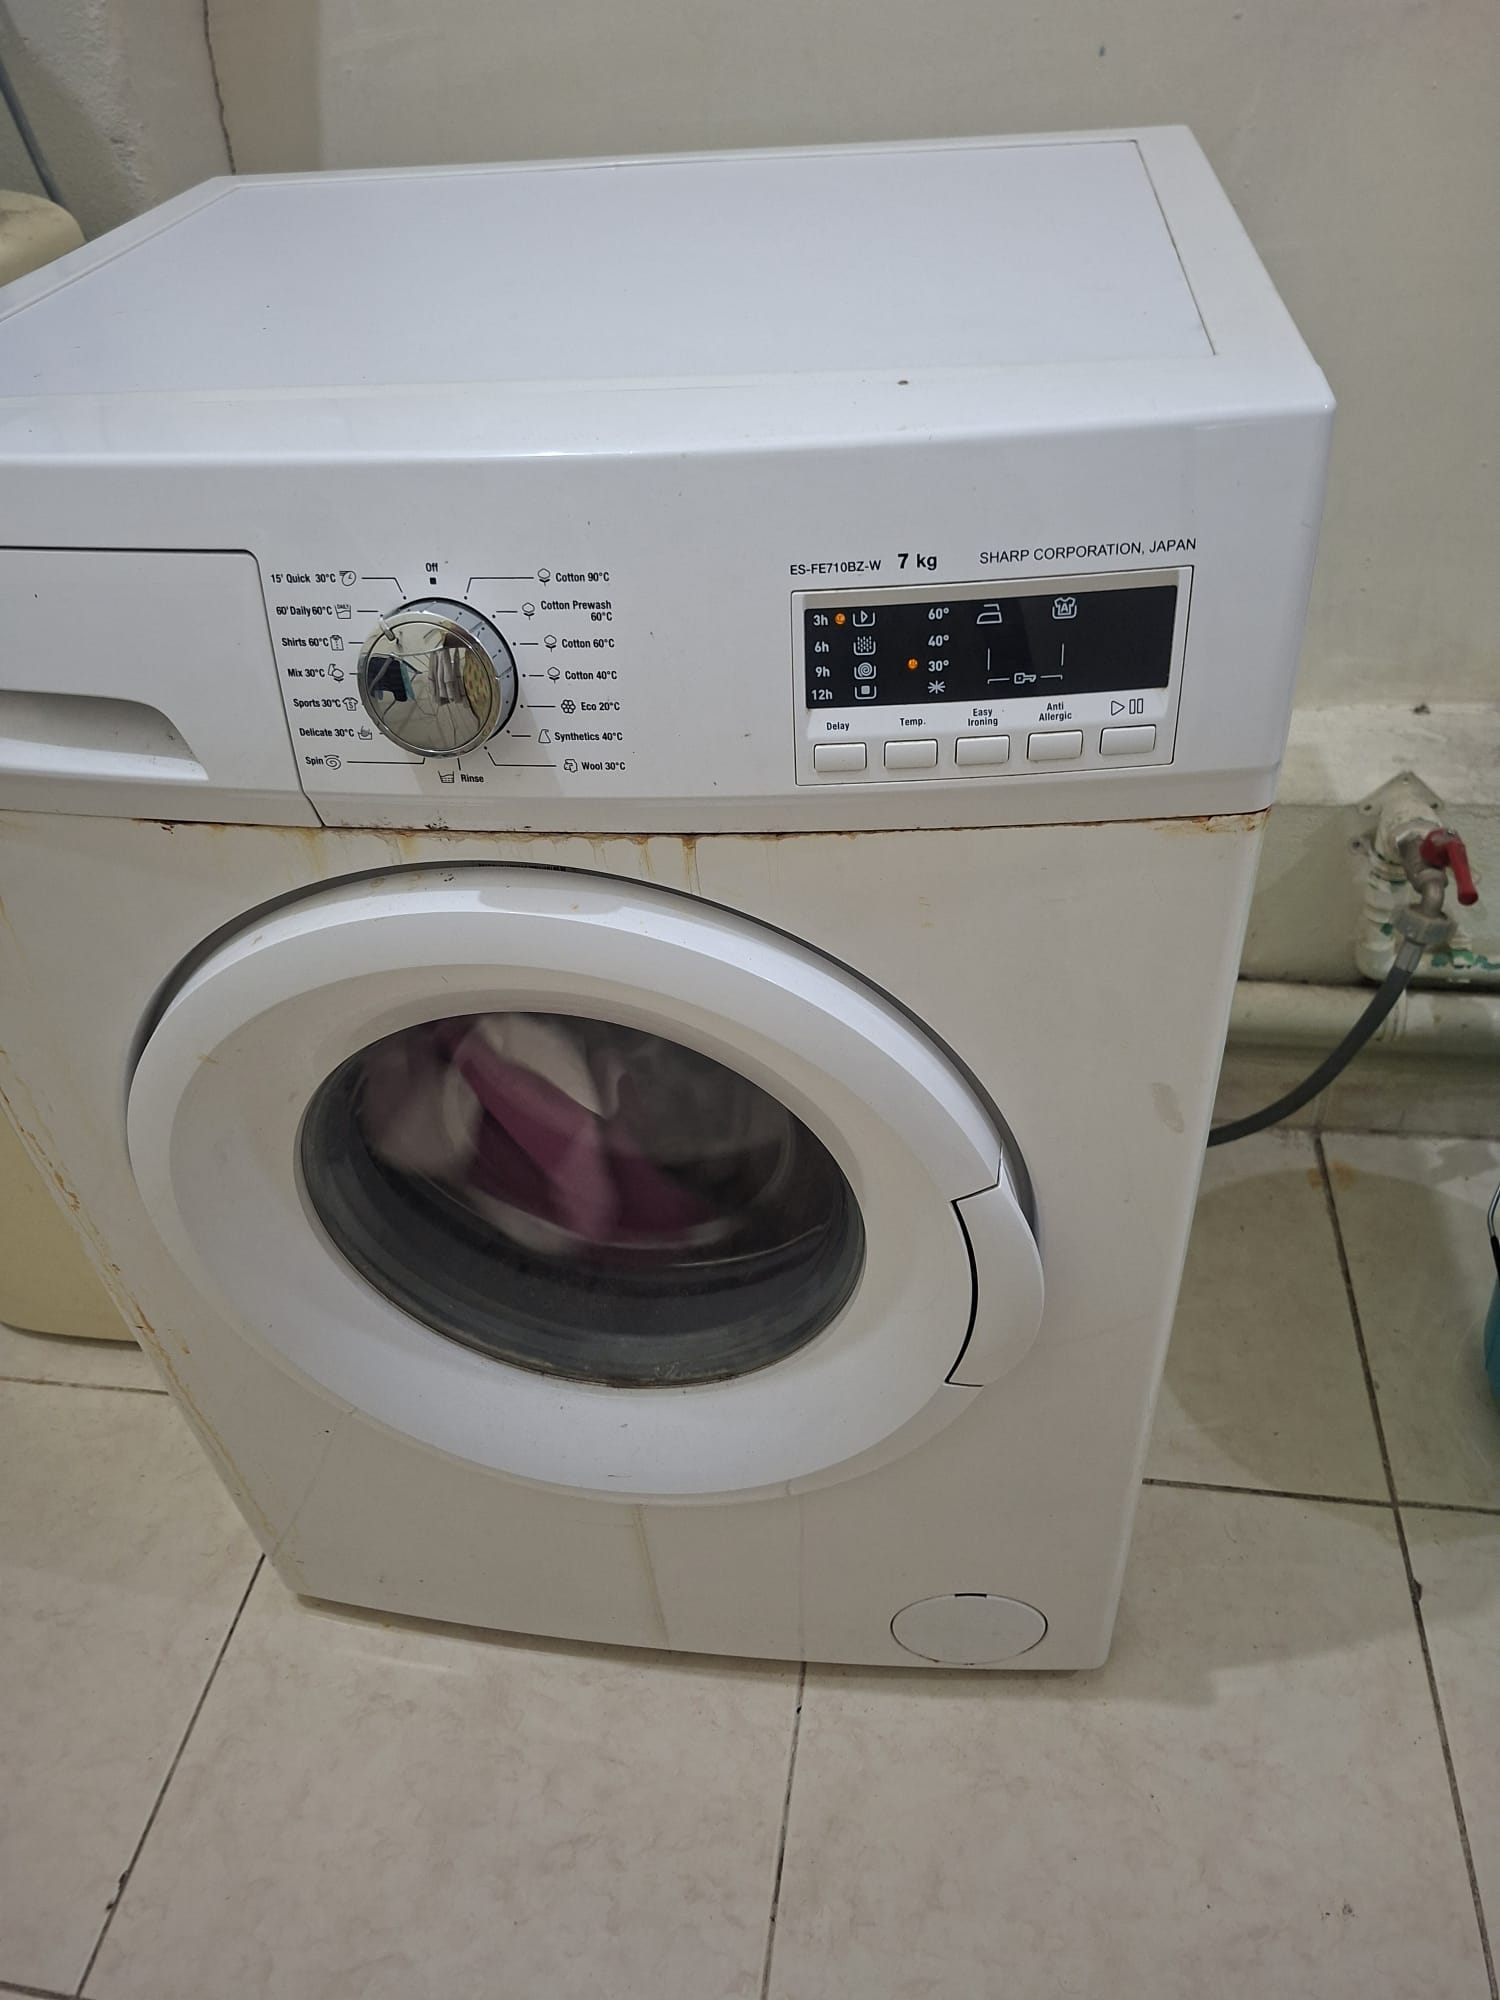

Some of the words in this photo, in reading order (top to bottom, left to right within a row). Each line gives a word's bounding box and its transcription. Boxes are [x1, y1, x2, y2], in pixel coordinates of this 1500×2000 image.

[979, 549, 1029, 564] SHARP
[1033, 543, 1144, 560] CORPORATION,
[1149, 539, 1196, 552] JAPAN
[898, 554, 909, 569] 7
[916, 554, 937, 569] kg
[426, 563, 438, 572] Off
[790, 560, 881, 575] ES-FE710BZ-W
[271, 574, 284, 583] 15'
[287, 574, 310, 583] Quick
[315, 574, 336, 583] 30°C
[556, 573, 585, 582] Cotton
[588, 573, 609, 581] 90°C
[541, 601, 570, 610] Cotton
[572, 601, 611, 610] Prewash
[290, 607, 311, 617] Daily
[312, 606, 332, 615] 60°C
[928, 608, 949, 620] 60°
[591, 612, 612, 621] 60°C
[813, 615, 828, 626] 3h
[282, 638, 306, 647] Shirts
[308, 638, 329, 646] 60°C
[562, 639, 591, 648] Cotton
[593, 639, 614, 648] 60°C
[928, 635, 949, 646] 40°
[815, 642, 829, 652] 6h
[928, 660, 949, 672] 30°
[288, 669, 303, 678] Mix
[305, 669, 325, 677] 30°C
[565, 671, 594, 680] Cotton
[596, 671, 617, 679] 40°C
[816, 667, 830, 677] 9h
[812, 690, 832, 700] 12h
[293, 699, 320, 709] Sports
[322, 699, 341, 707] 30°C
[581, 702, 596, 711] Eco
[599, 702, 620, 711] 20°C
[1047, 702, 1064, 711] Anti
[973, 708, 993, 717] Easy
[1039, 711, 1072, 721] Allergic
[827, 722, 849, 731] Delay
[900, 718, 926, 727] Temp.
[968, 718, 998, 727] Ironing
[300, 728, 332, 737] Delicate
[334, 729, 354, 737] 30°C
[555, 732, 599, 742] Synthetics
[602, 732, 623, 741] 40°C
[306, 757, 323, 766] Spin
[581, 762, 603, 770] Wool
[605, 762, 625, 770] 30°C
[461, 774, 484, 783] Rinse
